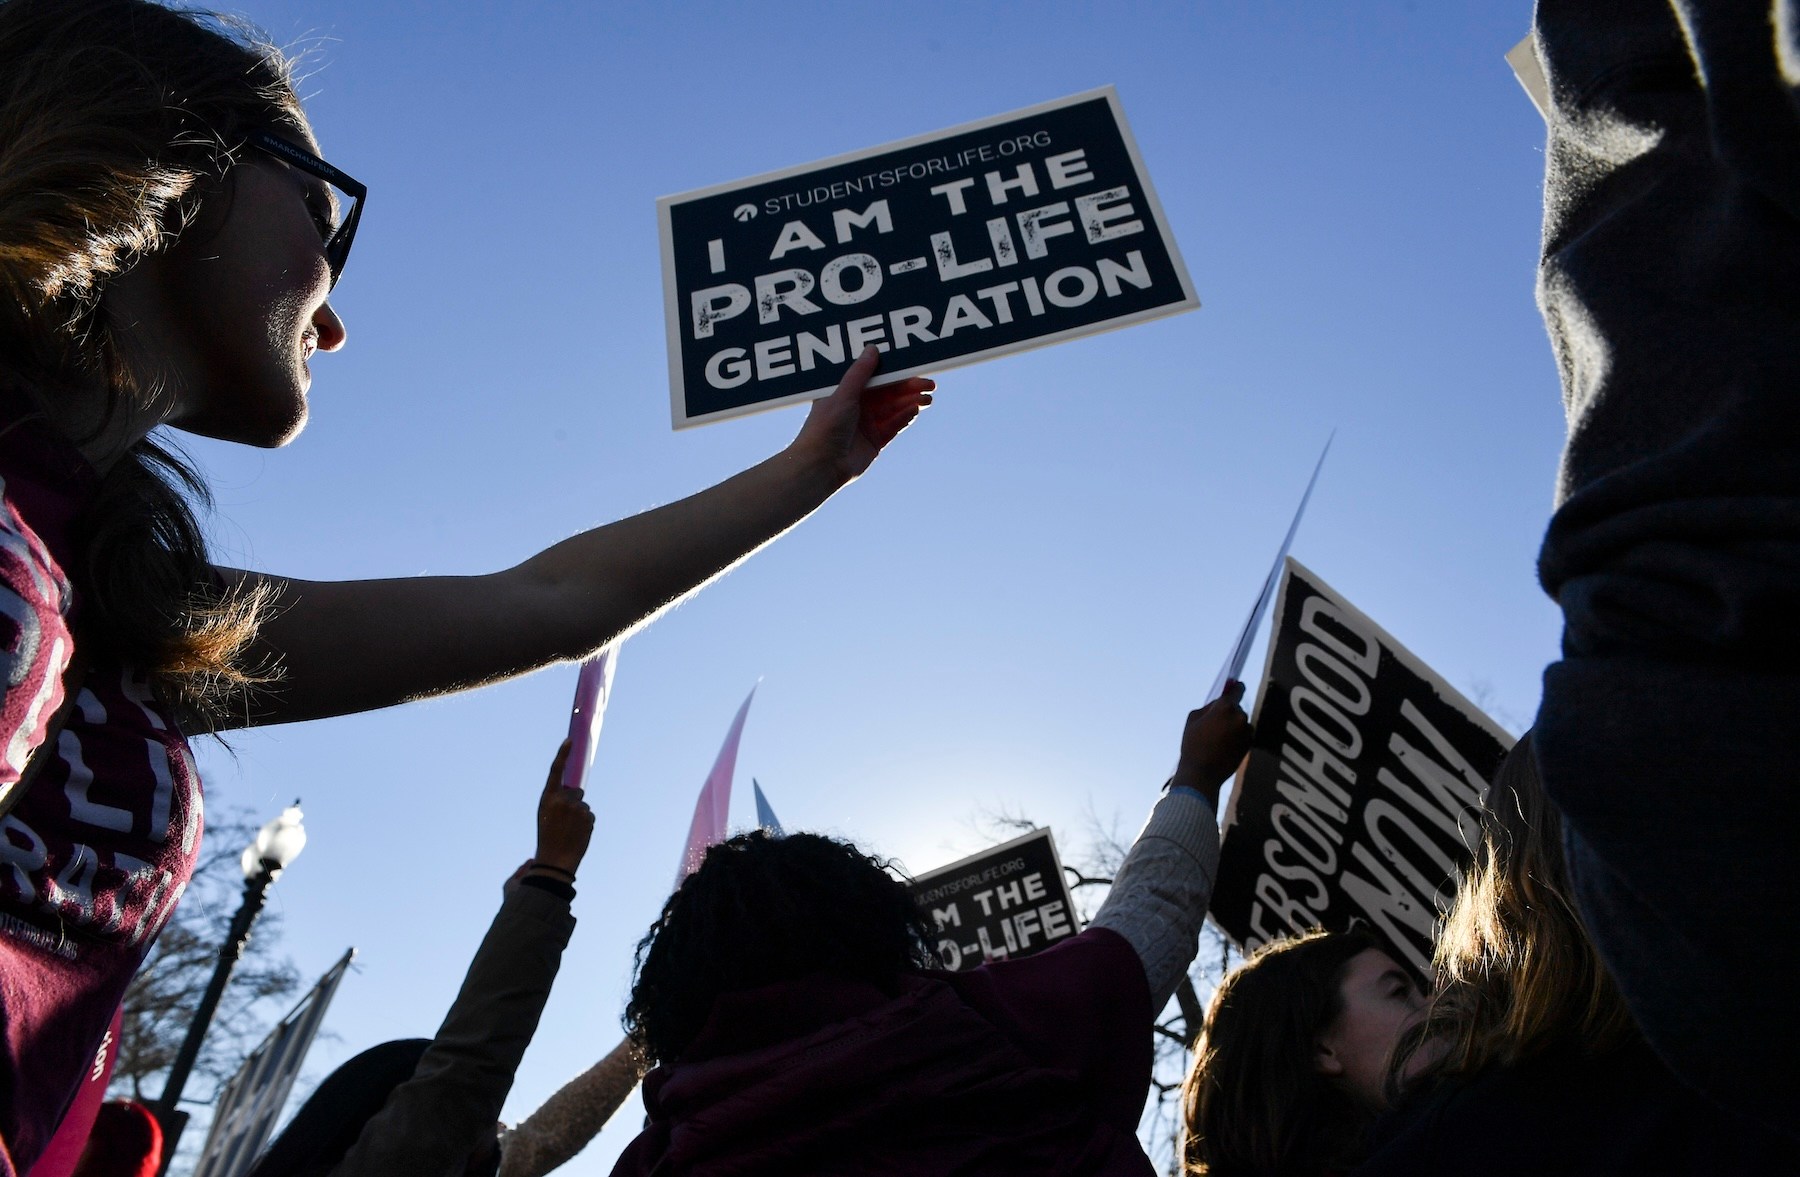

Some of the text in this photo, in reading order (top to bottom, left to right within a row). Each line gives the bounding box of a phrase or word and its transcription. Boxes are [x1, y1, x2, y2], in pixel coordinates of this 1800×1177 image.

[263, 136, 335, 177] #MARCH4LIFEUK
[764, 130, 1052, 216] STUDENTSFORLIFE.ORG
[691, 185, 1144, 340] PRO-LIFE
[708, 148, 1095, 274] I AM THE
[704, 250, 1153, 390] GENERATION
[1243, 595, 1380, 958] ERSONHOOD
[932, 872, 1048, 933] M THE
[937, 900, 1072, 972] O-LIFE
